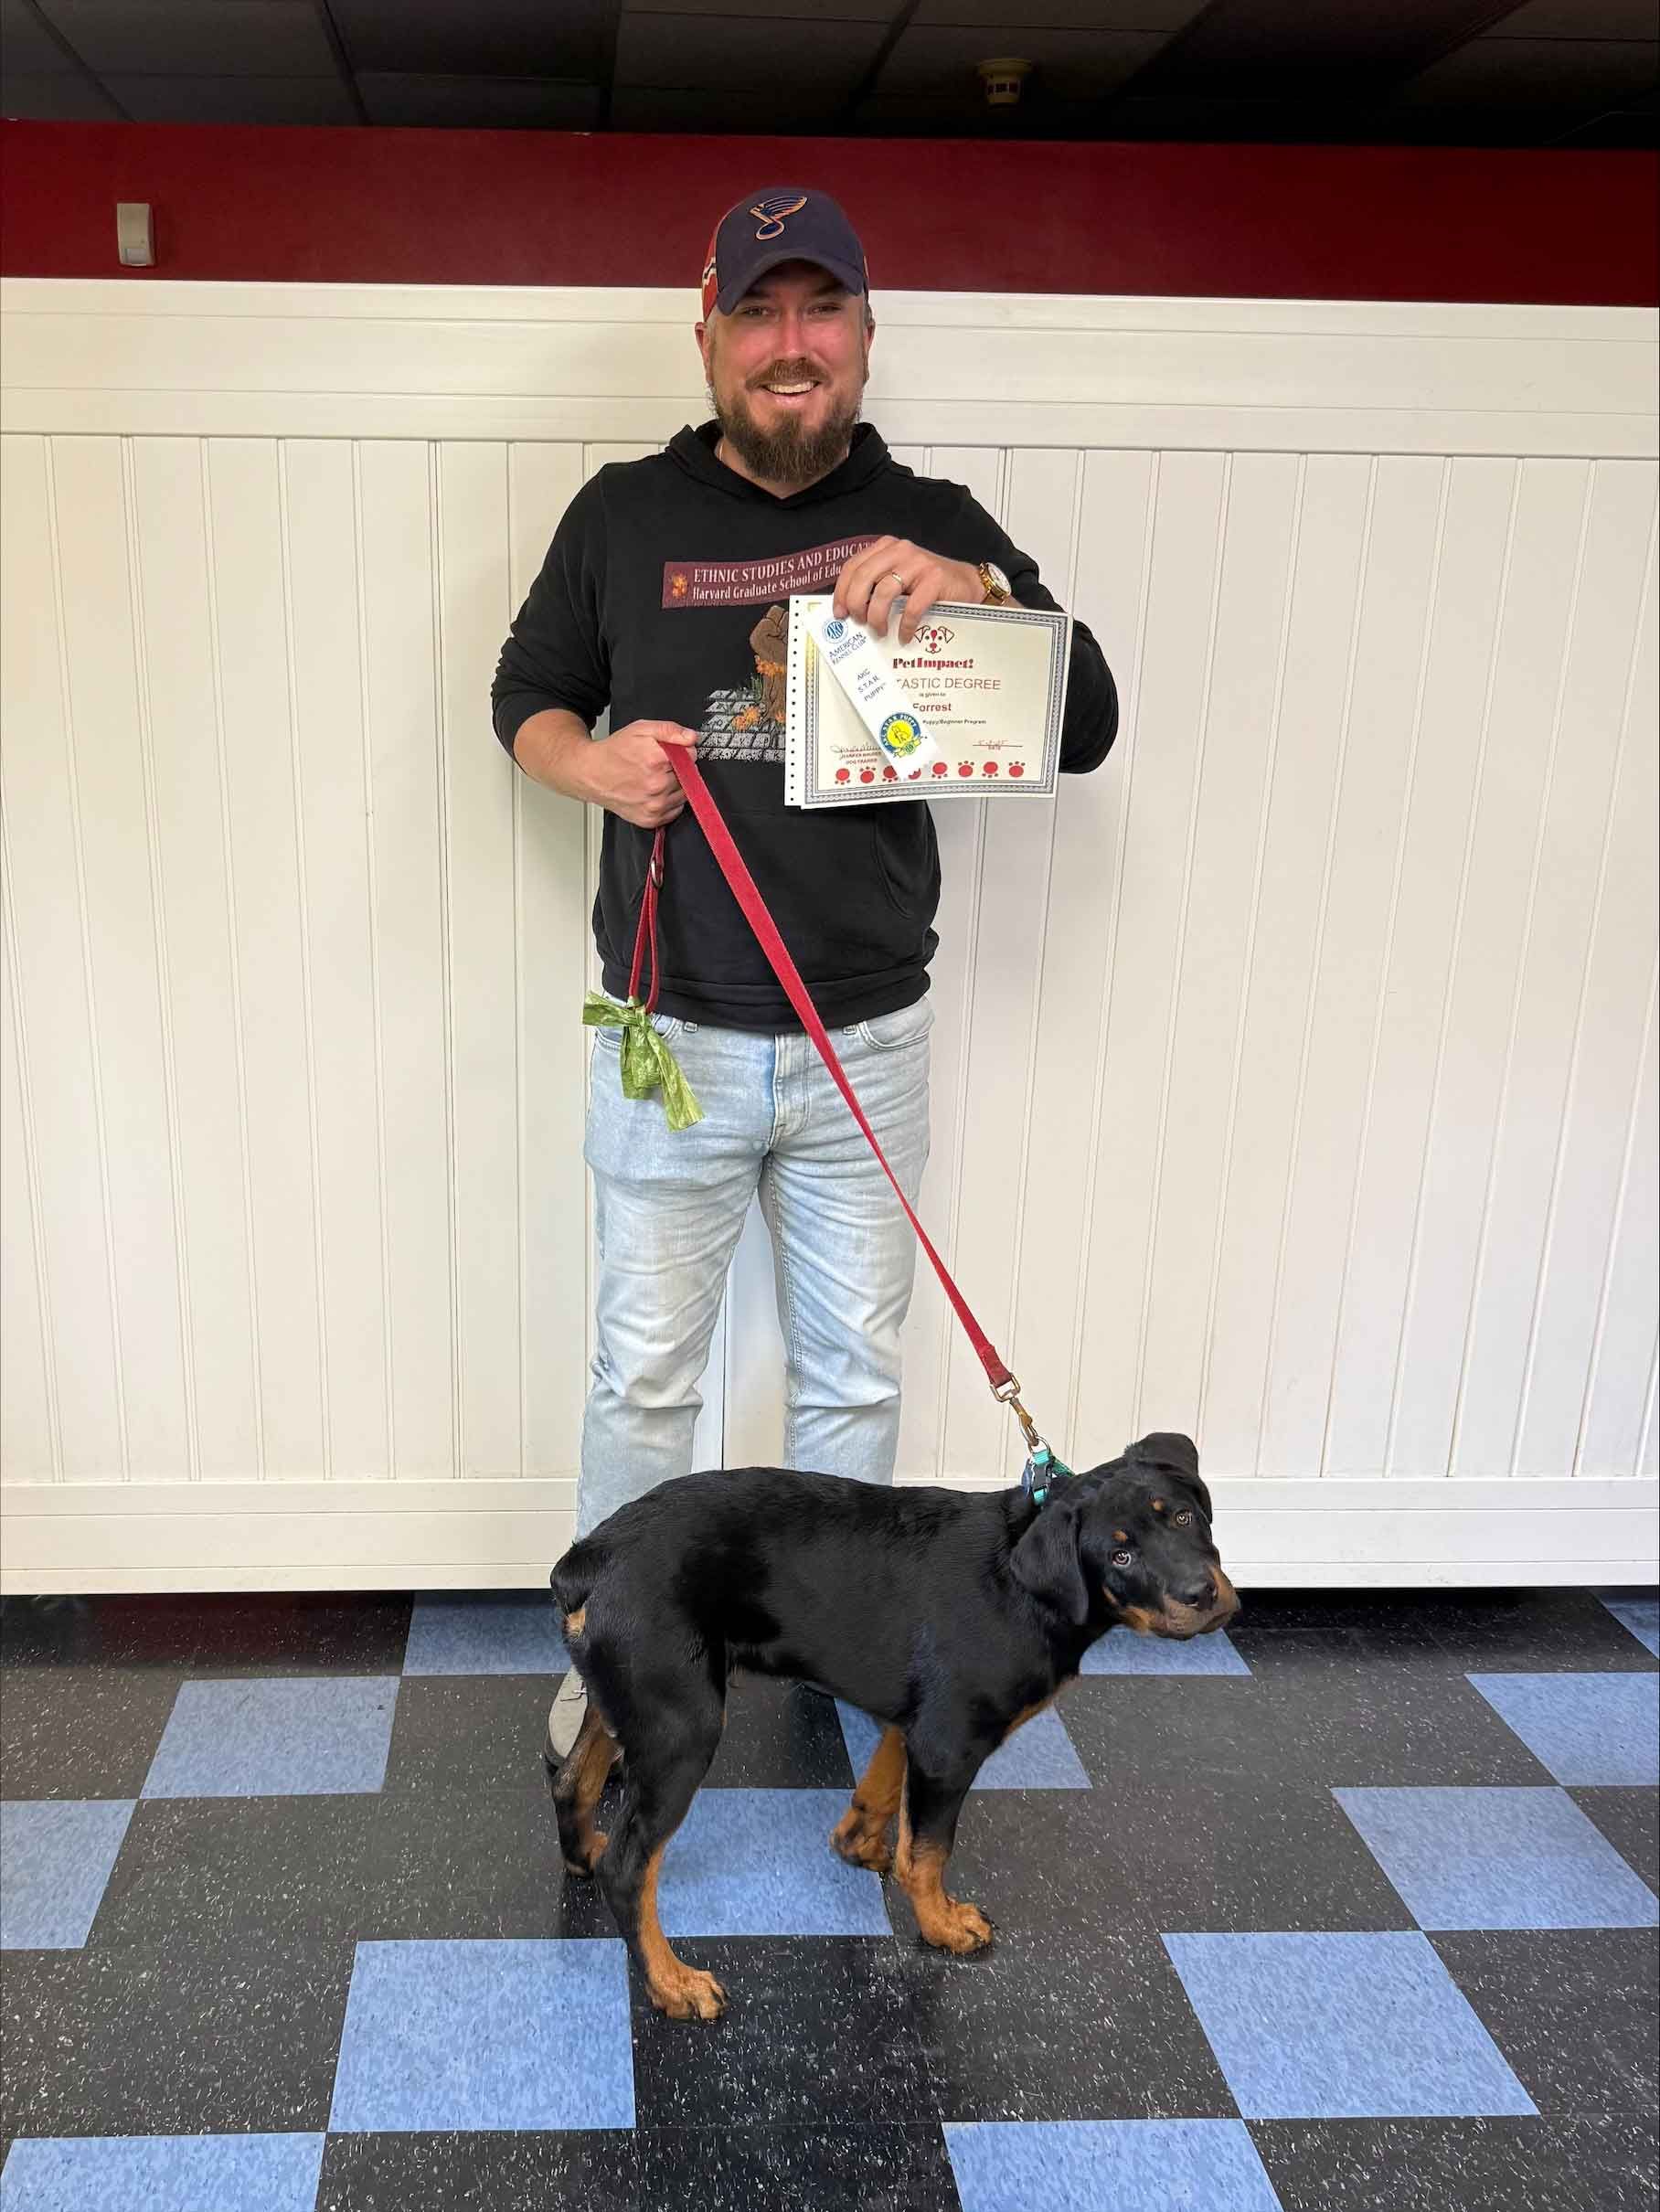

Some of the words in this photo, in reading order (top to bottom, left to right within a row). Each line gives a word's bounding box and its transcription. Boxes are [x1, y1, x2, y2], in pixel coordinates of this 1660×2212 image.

[694, 568, 739, 583] ETHNIC
[741, 558, 794, 582] STUDIES
[797, 551, 823, 570] AND
[693, 586, 731, 601] Harvard
[733, 581, 777, 598] Graduate
[779, 569, 811, 592] School
[813, 568, 824, 582] of
[828, 632, 863, 658] AMERICAN
[944, 678, 1001, 690] DEGREE
[912, 702, 952, 712] Forrest
